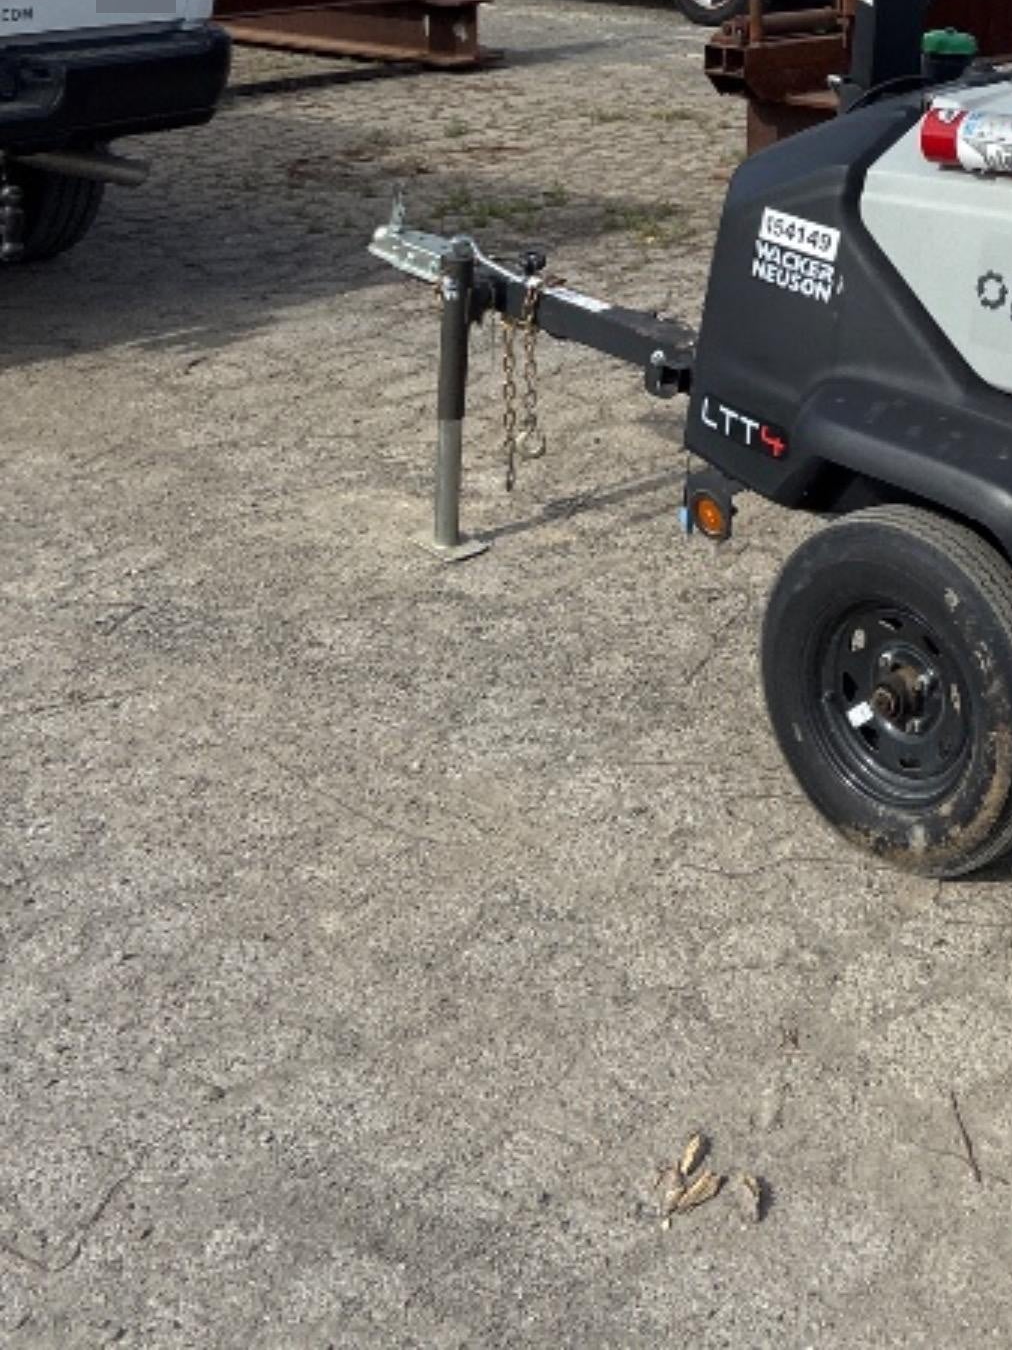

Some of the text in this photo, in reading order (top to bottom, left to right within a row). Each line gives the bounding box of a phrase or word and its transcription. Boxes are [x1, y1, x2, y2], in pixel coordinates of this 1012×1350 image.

[766, 214, 833, 252] 154149
[751, 257, 832, 305] NEUSON
[754, 239, 835, 284] WACKER
